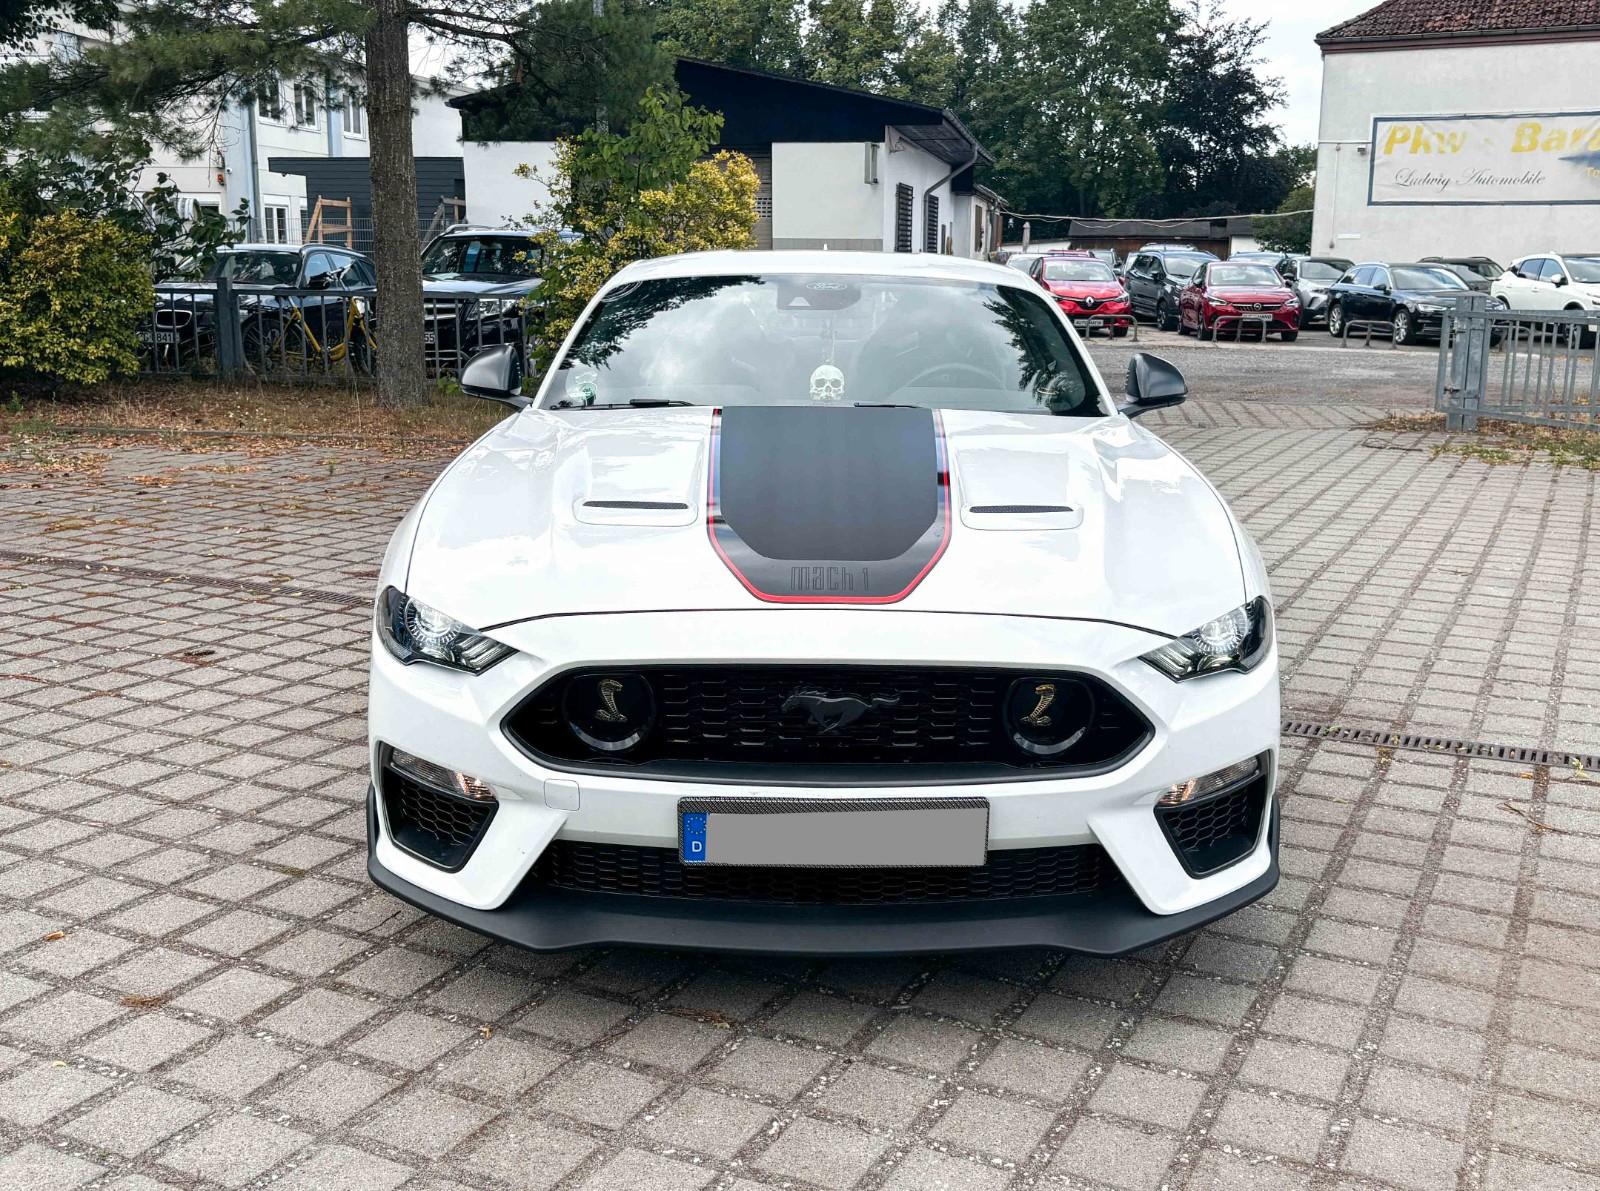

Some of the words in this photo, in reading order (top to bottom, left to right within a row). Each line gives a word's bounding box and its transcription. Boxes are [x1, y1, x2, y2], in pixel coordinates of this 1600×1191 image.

[1395, 167, 1451, 193] Ludwig
[1456, 167, 1546, 186] Automobile
[862, 567, 869, 591] 1
[691, 841, 703, 853] D
